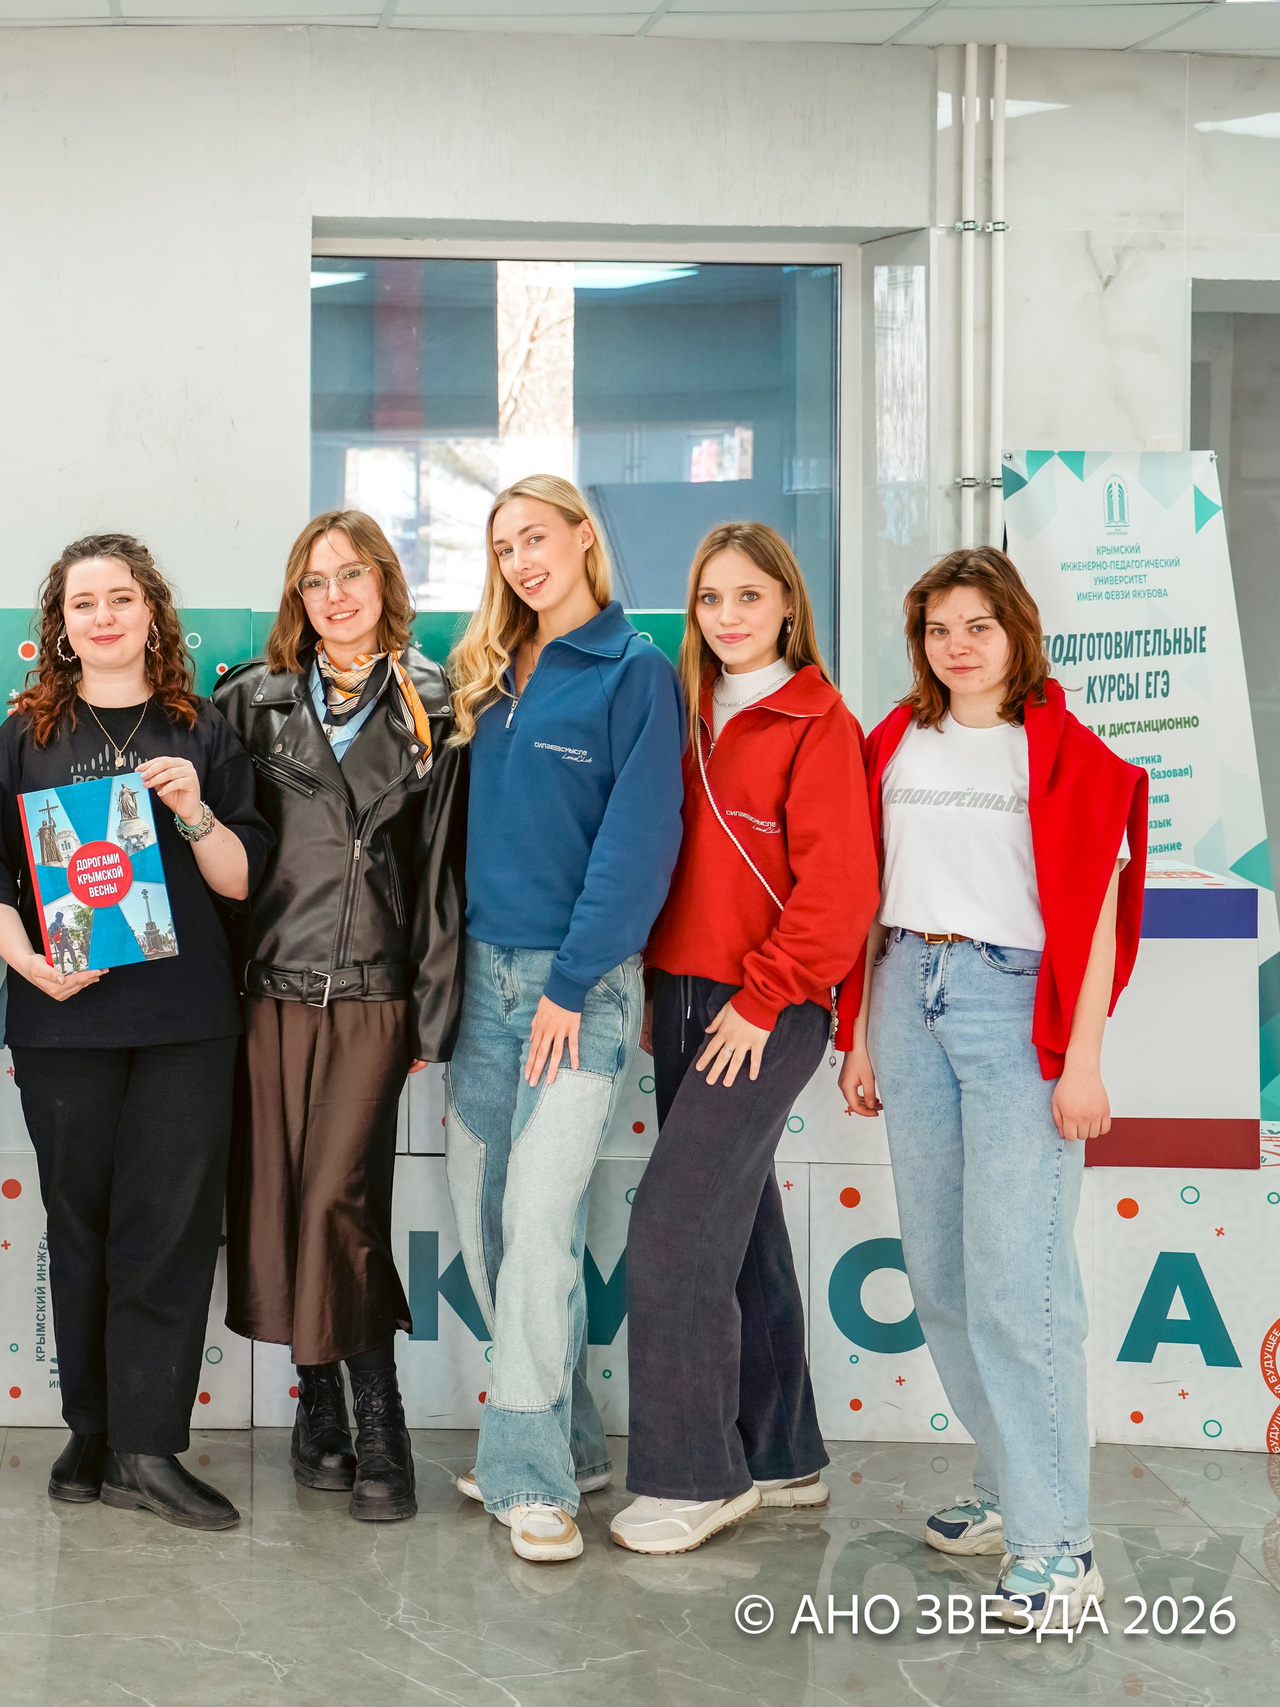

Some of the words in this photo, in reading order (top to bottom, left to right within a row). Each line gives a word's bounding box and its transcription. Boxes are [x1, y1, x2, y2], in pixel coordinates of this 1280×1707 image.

[1096, 543, 1141, 556] КРЫМСКИЙ
[1060, 556, 1181, 571] ИНЖЕНЕРНО-ПЕДАГОГИЧЕСКИЙ
[1093, 574, 1148, 586] УНИВЕРСИТЕТ
[1076, 591, 1103, 602] ИМЕНИ
[1104, 590, 1130, 600] ФЕВЗИ
[1132, 588, 1168, 599] ЯКУБОВА
[1086, 672, 1139, 704] КУРСЫ
[1145, 669, 1170, 699] ЕГЭ
[1097, 724, 1106, 737] И
[1108, 715, 1200, 738] ДИСТАНЦИОННО
[1150, 765, 1193, 780] базовая)
[76, 852, 120, 872] ДОРОГАМИ
[77, 865, 124, 885] КРЫМСКОЙ
[88, 882, 118, 898] ВЕСНЫ
[34, 1286, 46, 1362] КРЫМСКИЙ
